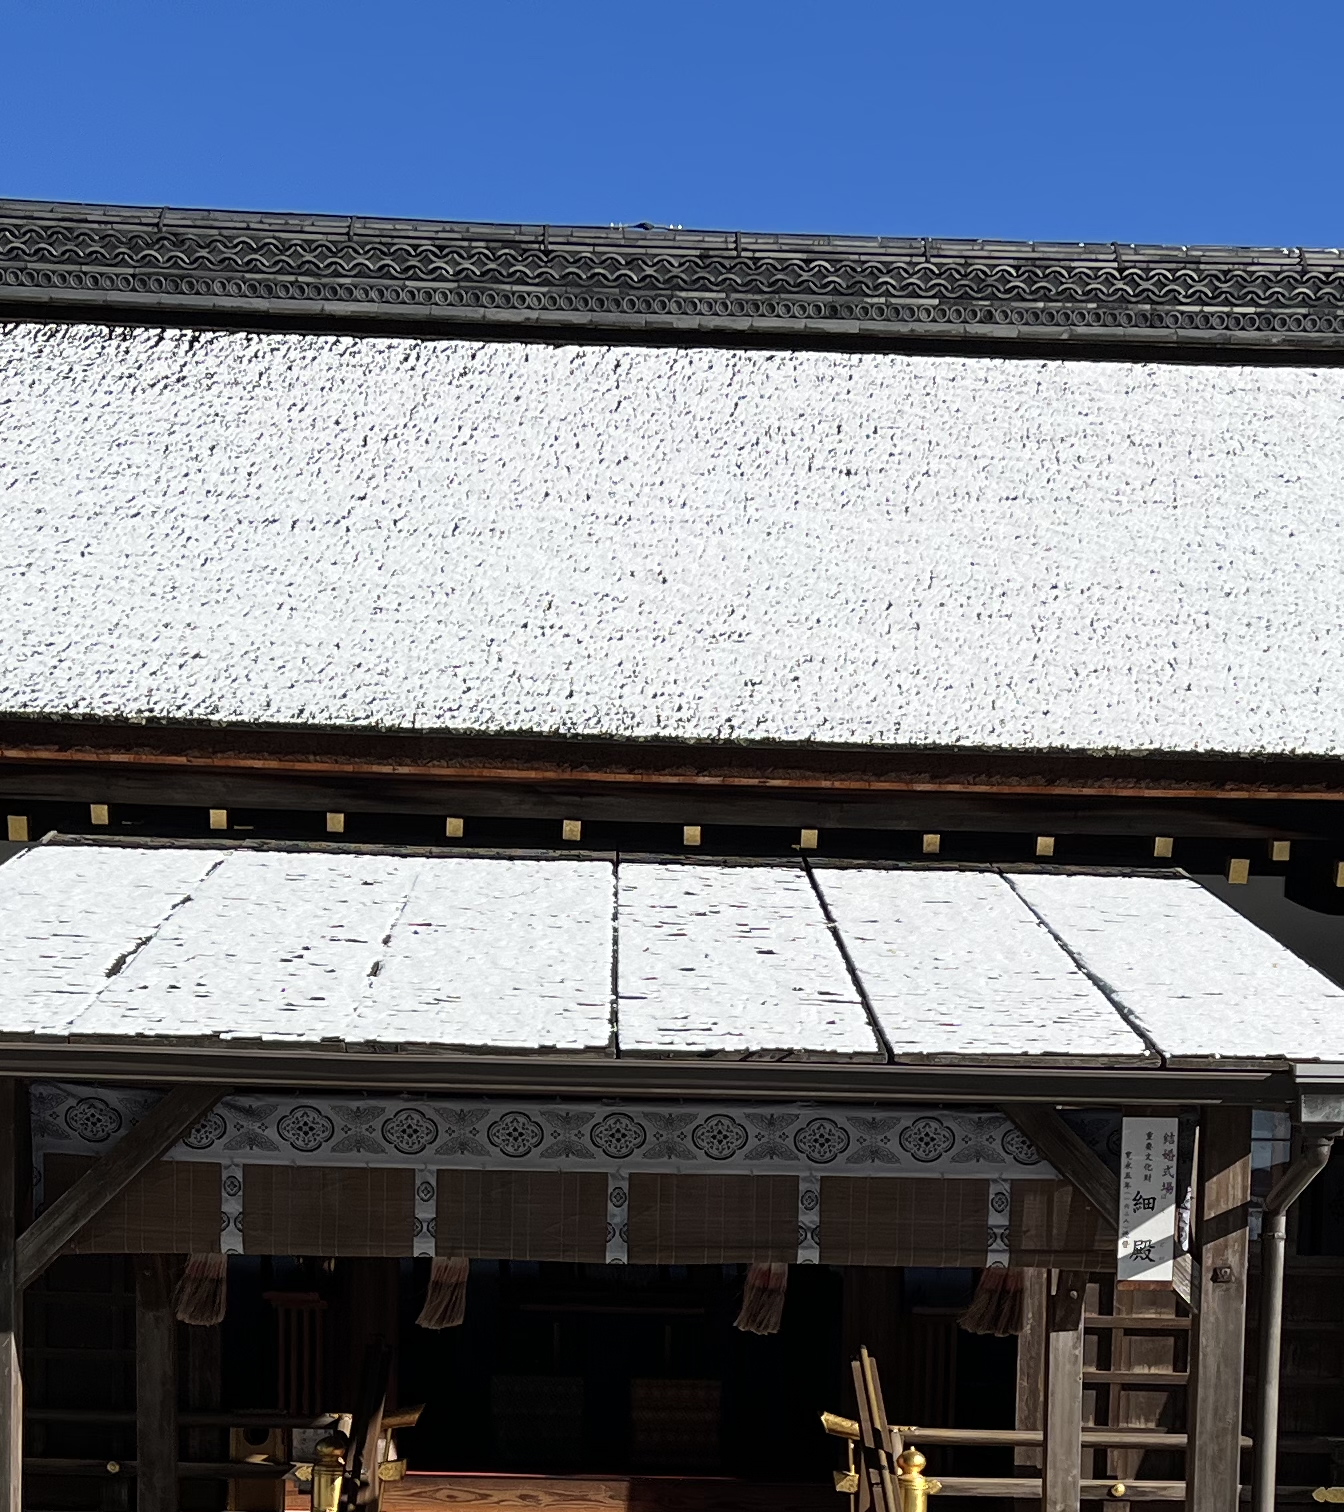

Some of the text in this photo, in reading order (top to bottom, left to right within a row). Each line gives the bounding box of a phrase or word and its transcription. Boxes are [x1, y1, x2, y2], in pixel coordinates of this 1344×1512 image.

[1143, 1131, 1154, 1183] 重要文化財
[1160, 1131, 1176, 1195] 結婚式場
[1129, 1190, 1156, 1263] 細殿
